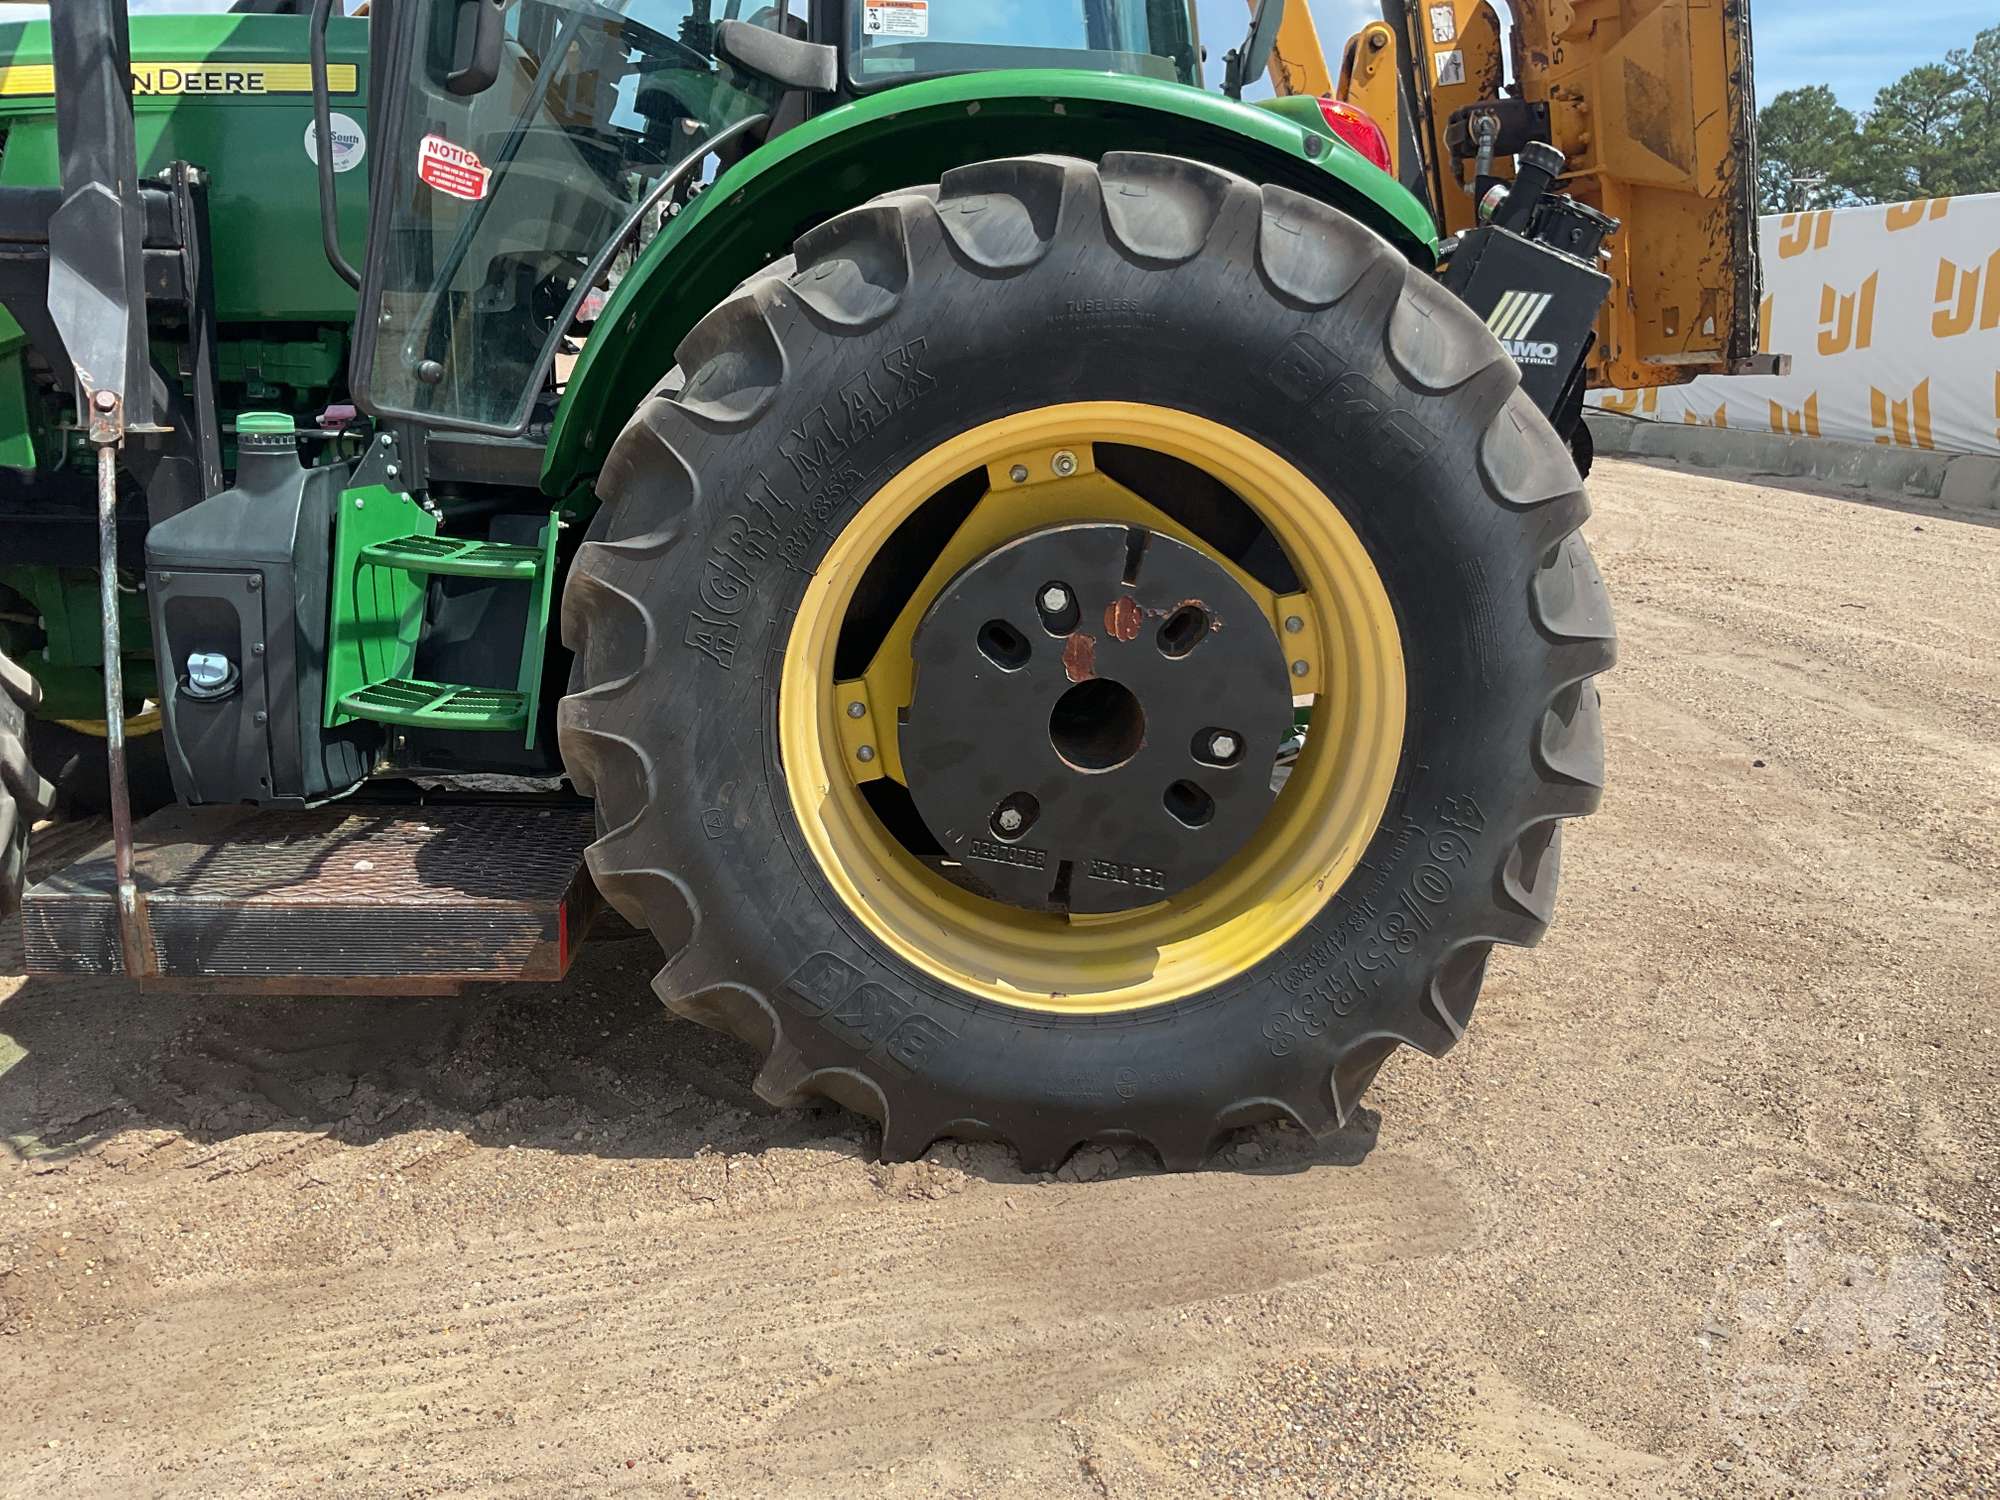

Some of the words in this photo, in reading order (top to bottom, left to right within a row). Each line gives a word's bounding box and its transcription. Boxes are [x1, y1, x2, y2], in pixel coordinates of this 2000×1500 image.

[159, 69, 264, 91] DEERE
[1066, 298, 1138, 312] TUBELESS
[1262, 787, 1488, 1057] 460/85R38
